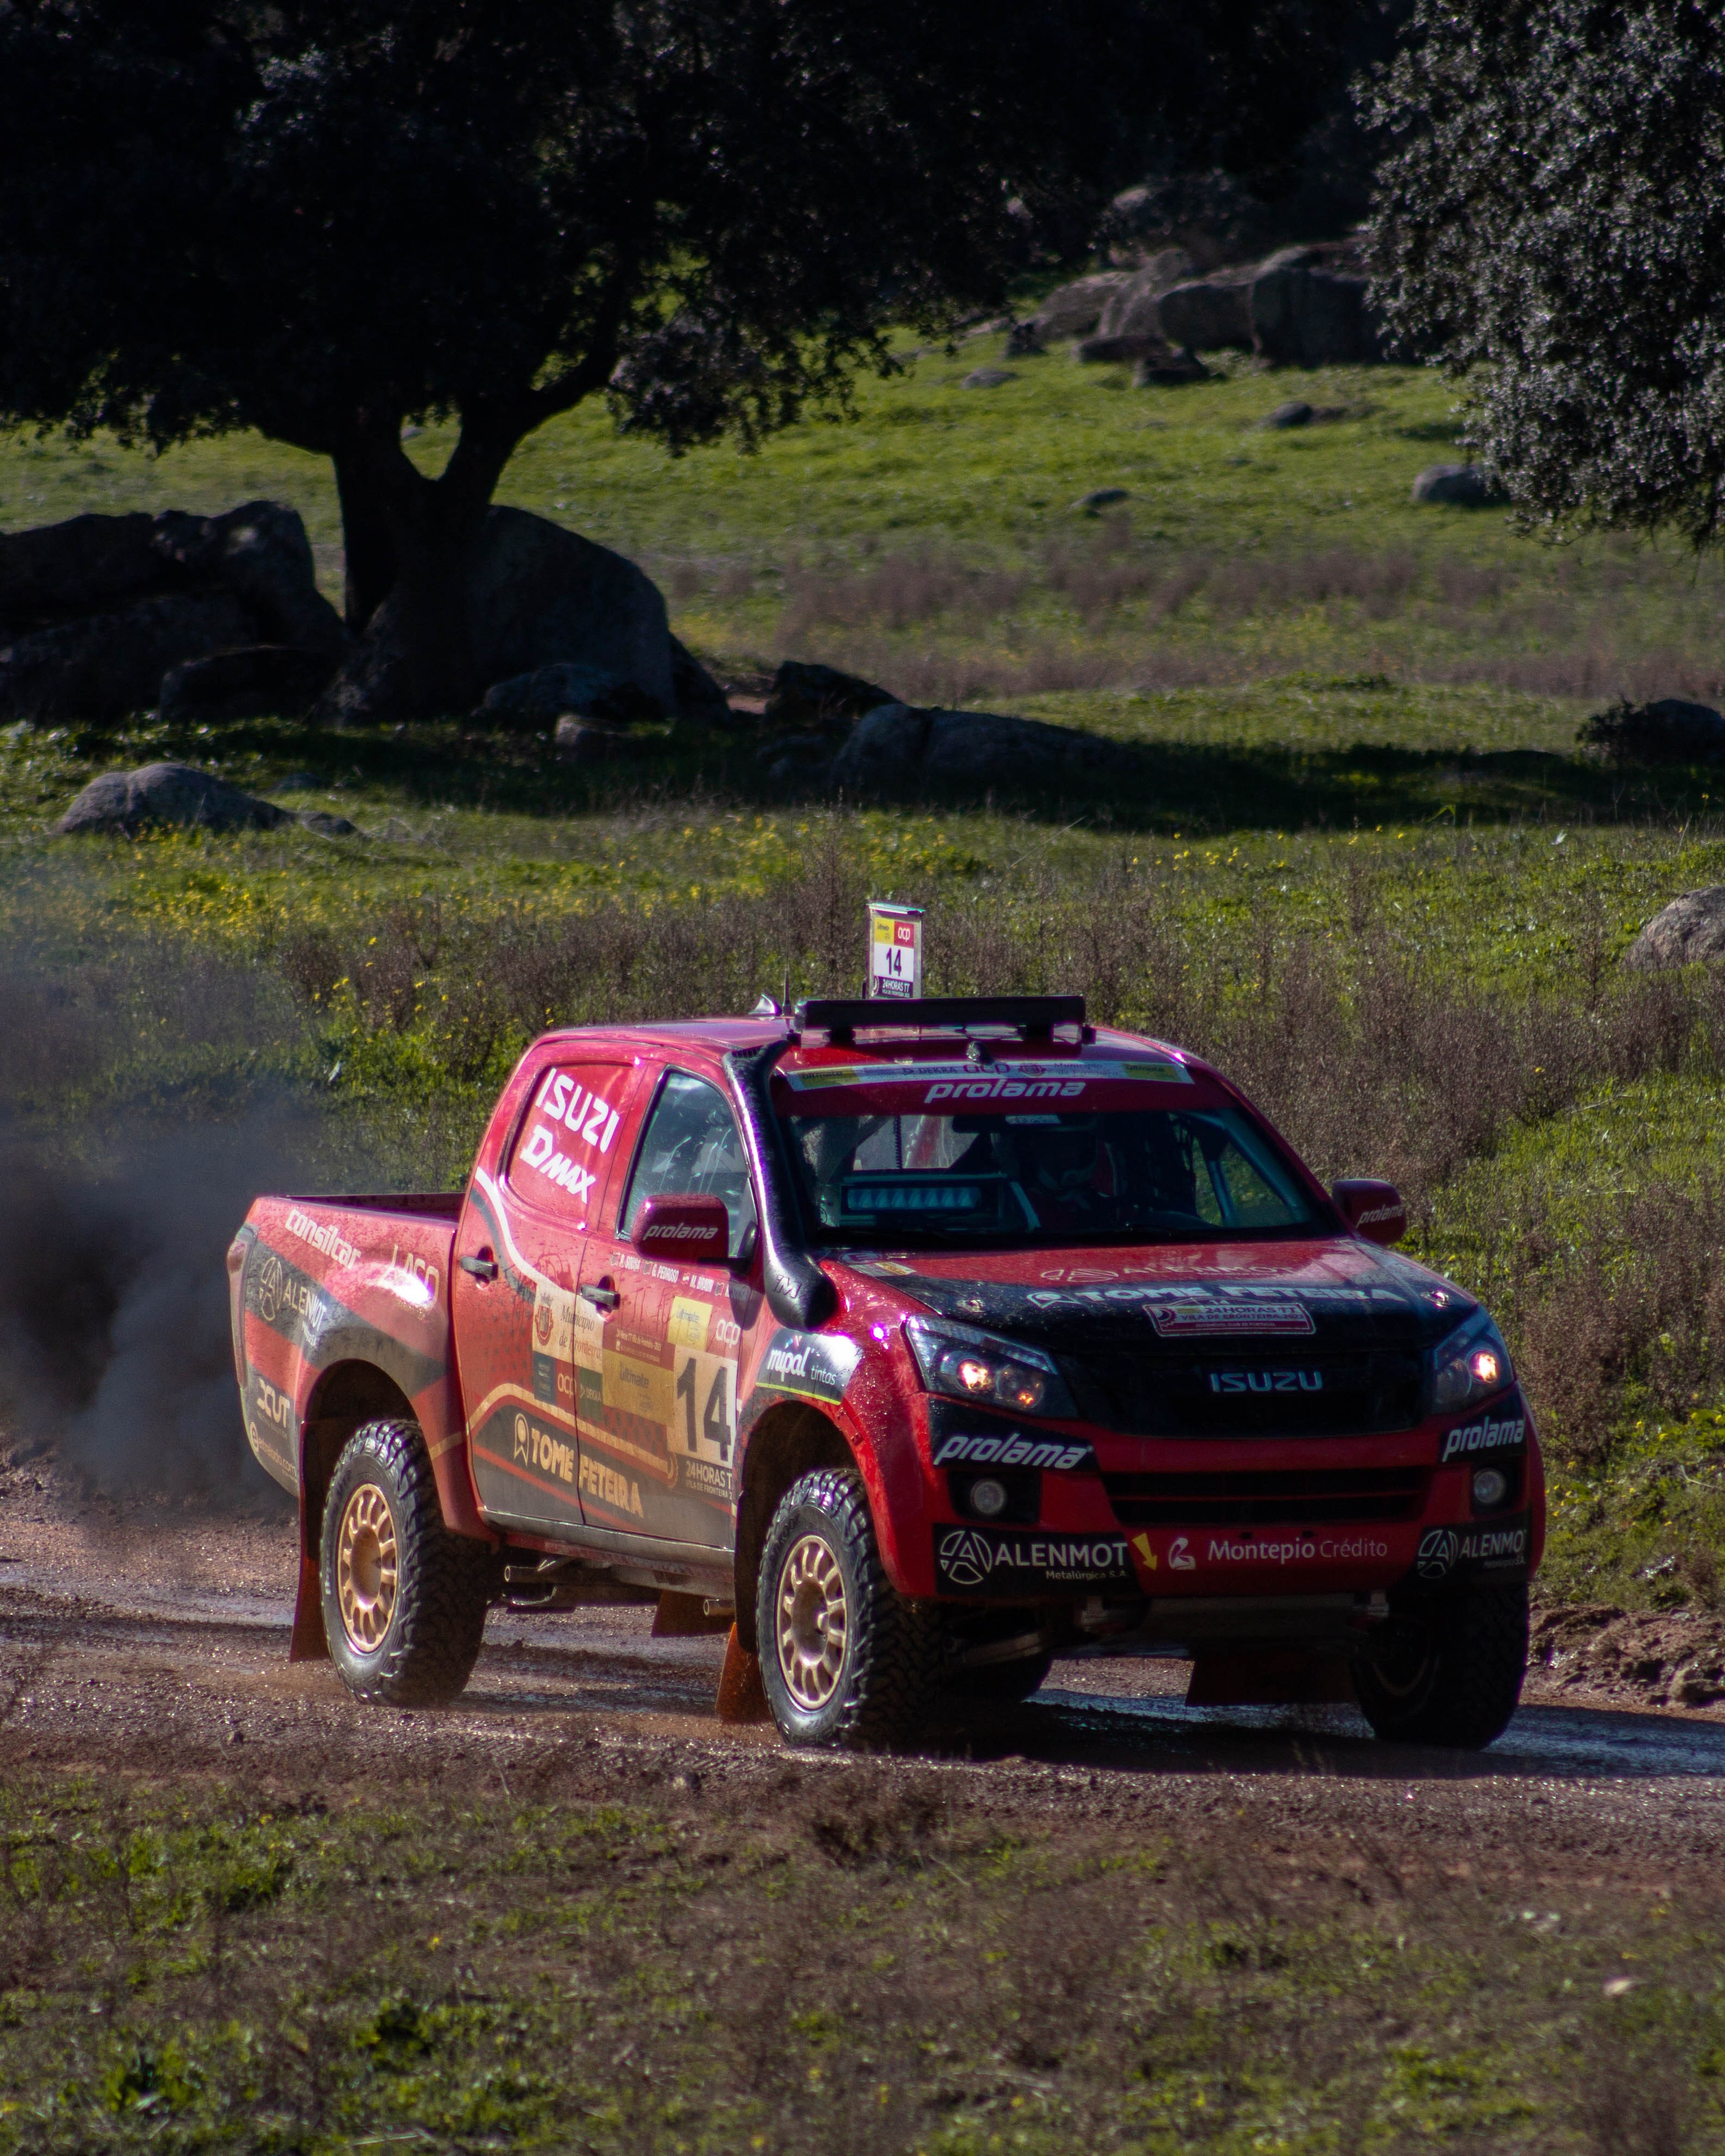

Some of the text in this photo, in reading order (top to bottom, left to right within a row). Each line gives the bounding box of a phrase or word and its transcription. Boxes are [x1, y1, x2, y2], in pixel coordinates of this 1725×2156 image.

[885, 947, 902, 977] 14
[924, 1079, 1086, 1104] prolama
[641, 1222, 719, 1241] prolama
[1218, 1286, 1408, 1302] FETEIRA
[1210, 1370, 1323, 1393] ISUZU
[677, 1357, 732, 1463] 14
[933, 1433, 1089, 1469] prolama
[1442, 1416, 1526, 1463] prolama
[579, 1453, 644, 1519] FETEIRA
[995, 1542, 1129, 1567] ALENMOT
[1208, 1537, 1388, 1565] Montepio Crédito
